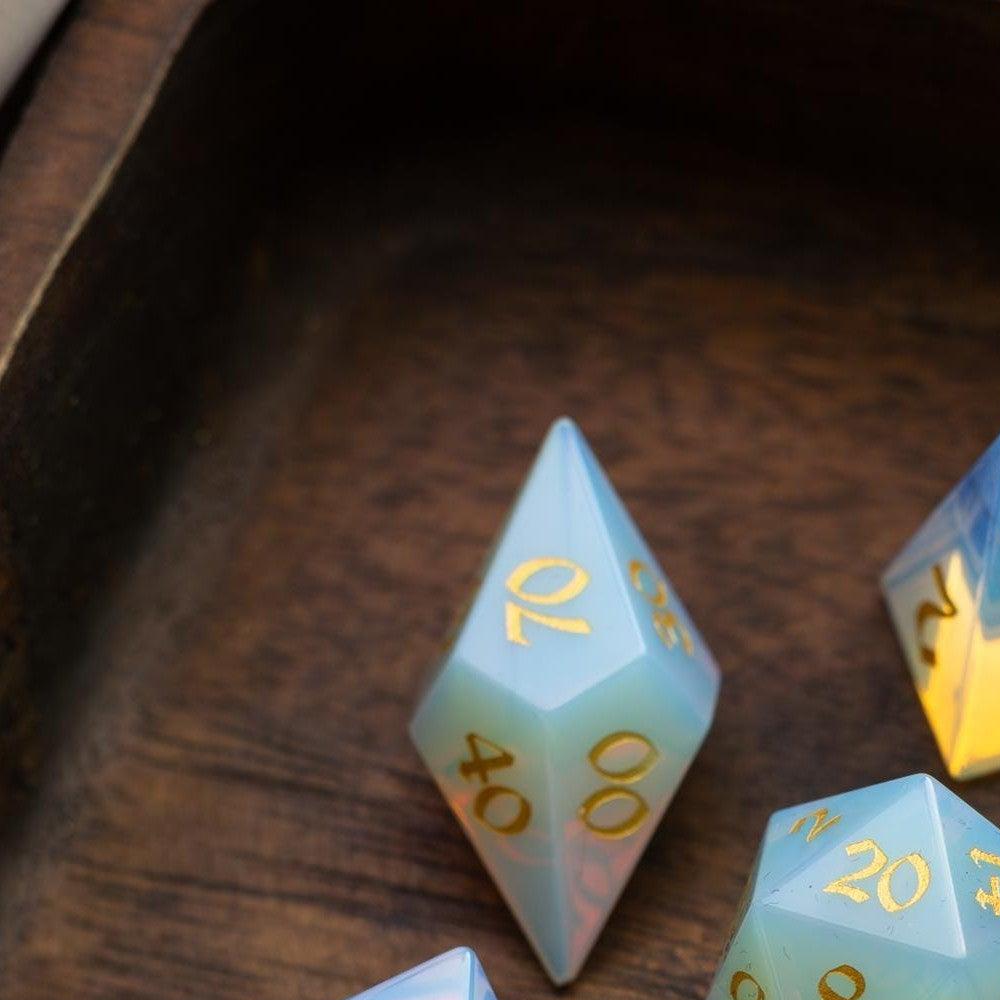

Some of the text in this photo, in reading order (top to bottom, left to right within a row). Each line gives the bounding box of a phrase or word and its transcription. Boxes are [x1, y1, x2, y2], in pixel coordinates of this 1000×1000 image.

[505, 557, 592, 645] 70
[458, 731, 533, 836] 40
[577, 730, 661, 840] 00
[788, 808, 842, 842] 2
[822, 838, 931, 913] 20
